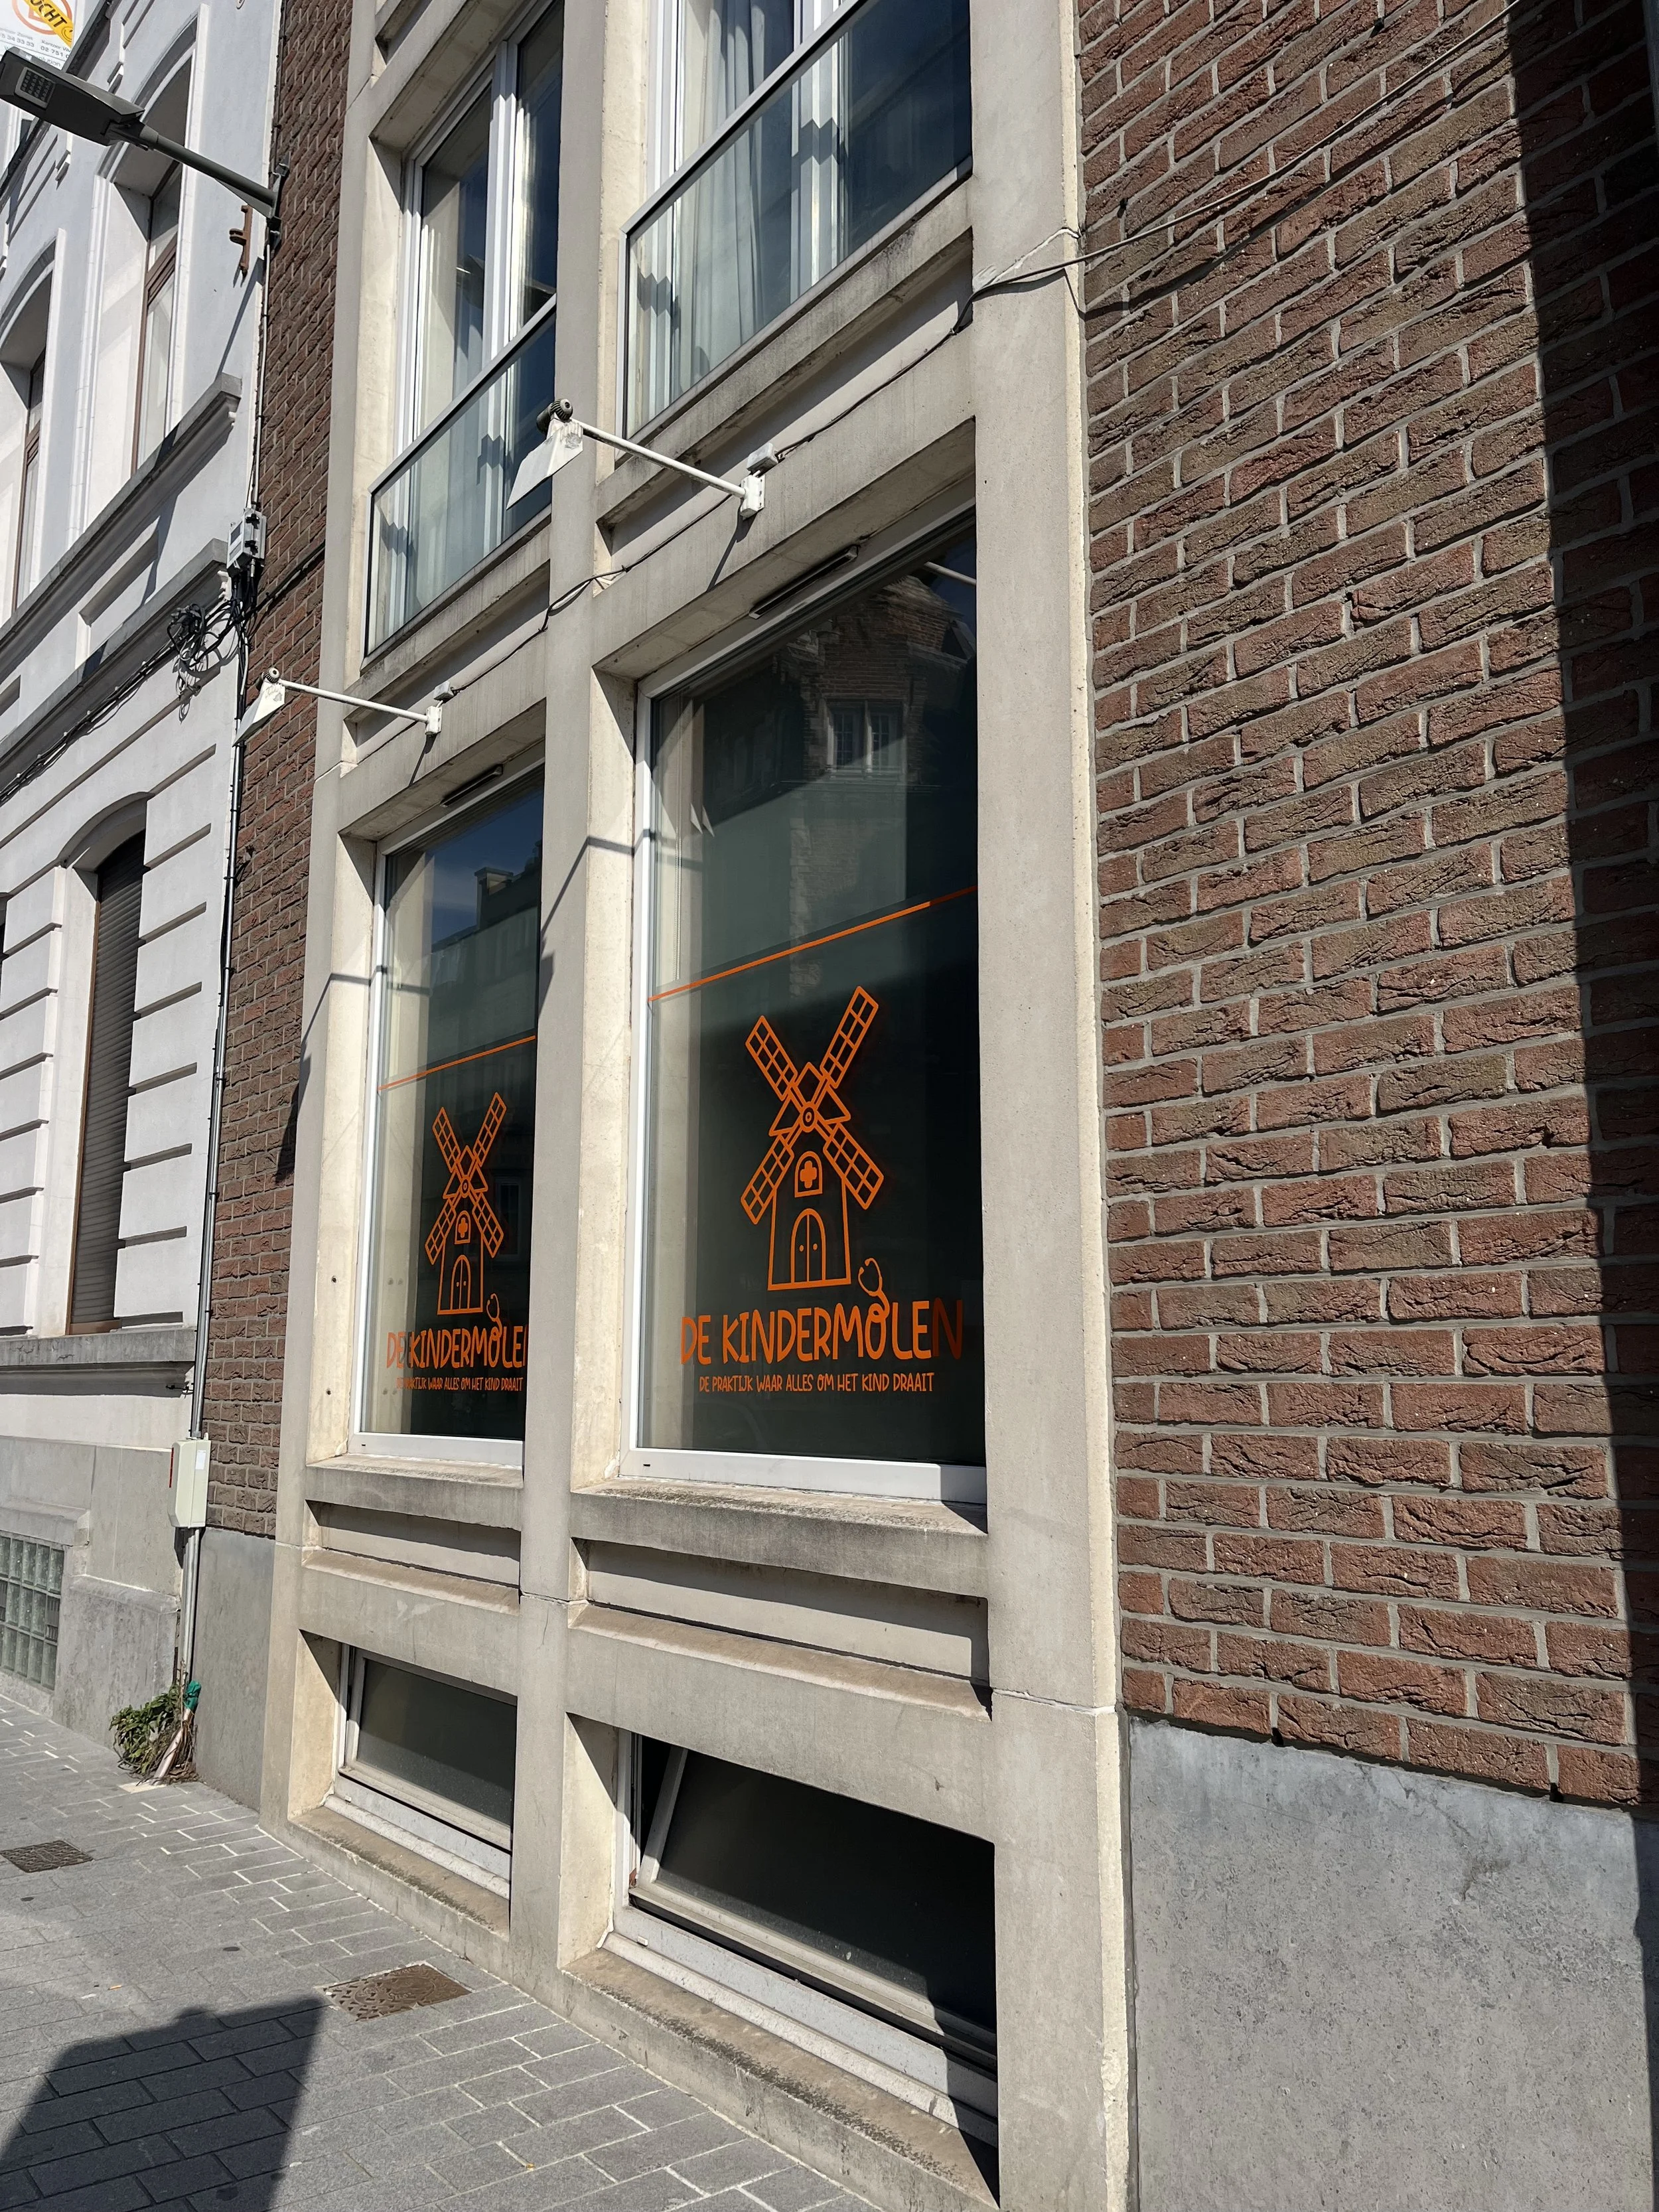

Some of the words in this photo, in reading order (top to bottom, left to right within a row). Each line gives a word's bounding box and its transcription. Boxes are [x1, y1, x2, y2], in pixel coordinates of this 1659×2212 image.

[680, 1315, 712, 1364] DE
[722, 1297, 964, 1365] KINDERMOLEN
[387, 1331, 407, 1369] DE
[444, 1376, 460, 1391] ALLES
[461, 1376, 470, 1390] OM
[471, 1376, 484, 1390] HET
[484, 1376, 500, 1392] KIND
[501, 1376, 524, 1392] DRAAIT
[699, 1376, 710, 1393] DE
[712, 1374, 754, 1392] PRAKTIJK
[756, 1374, 783, 1392] WAAR
[786, 1374, 814, 1392] ALLES
[817, 1373, 835, 1392] OM
[837, 1373, 859, 1392] HET
[862, 1372, 890, 1392] KIND
[893, 1372, 934, 1392] DRAAIT
